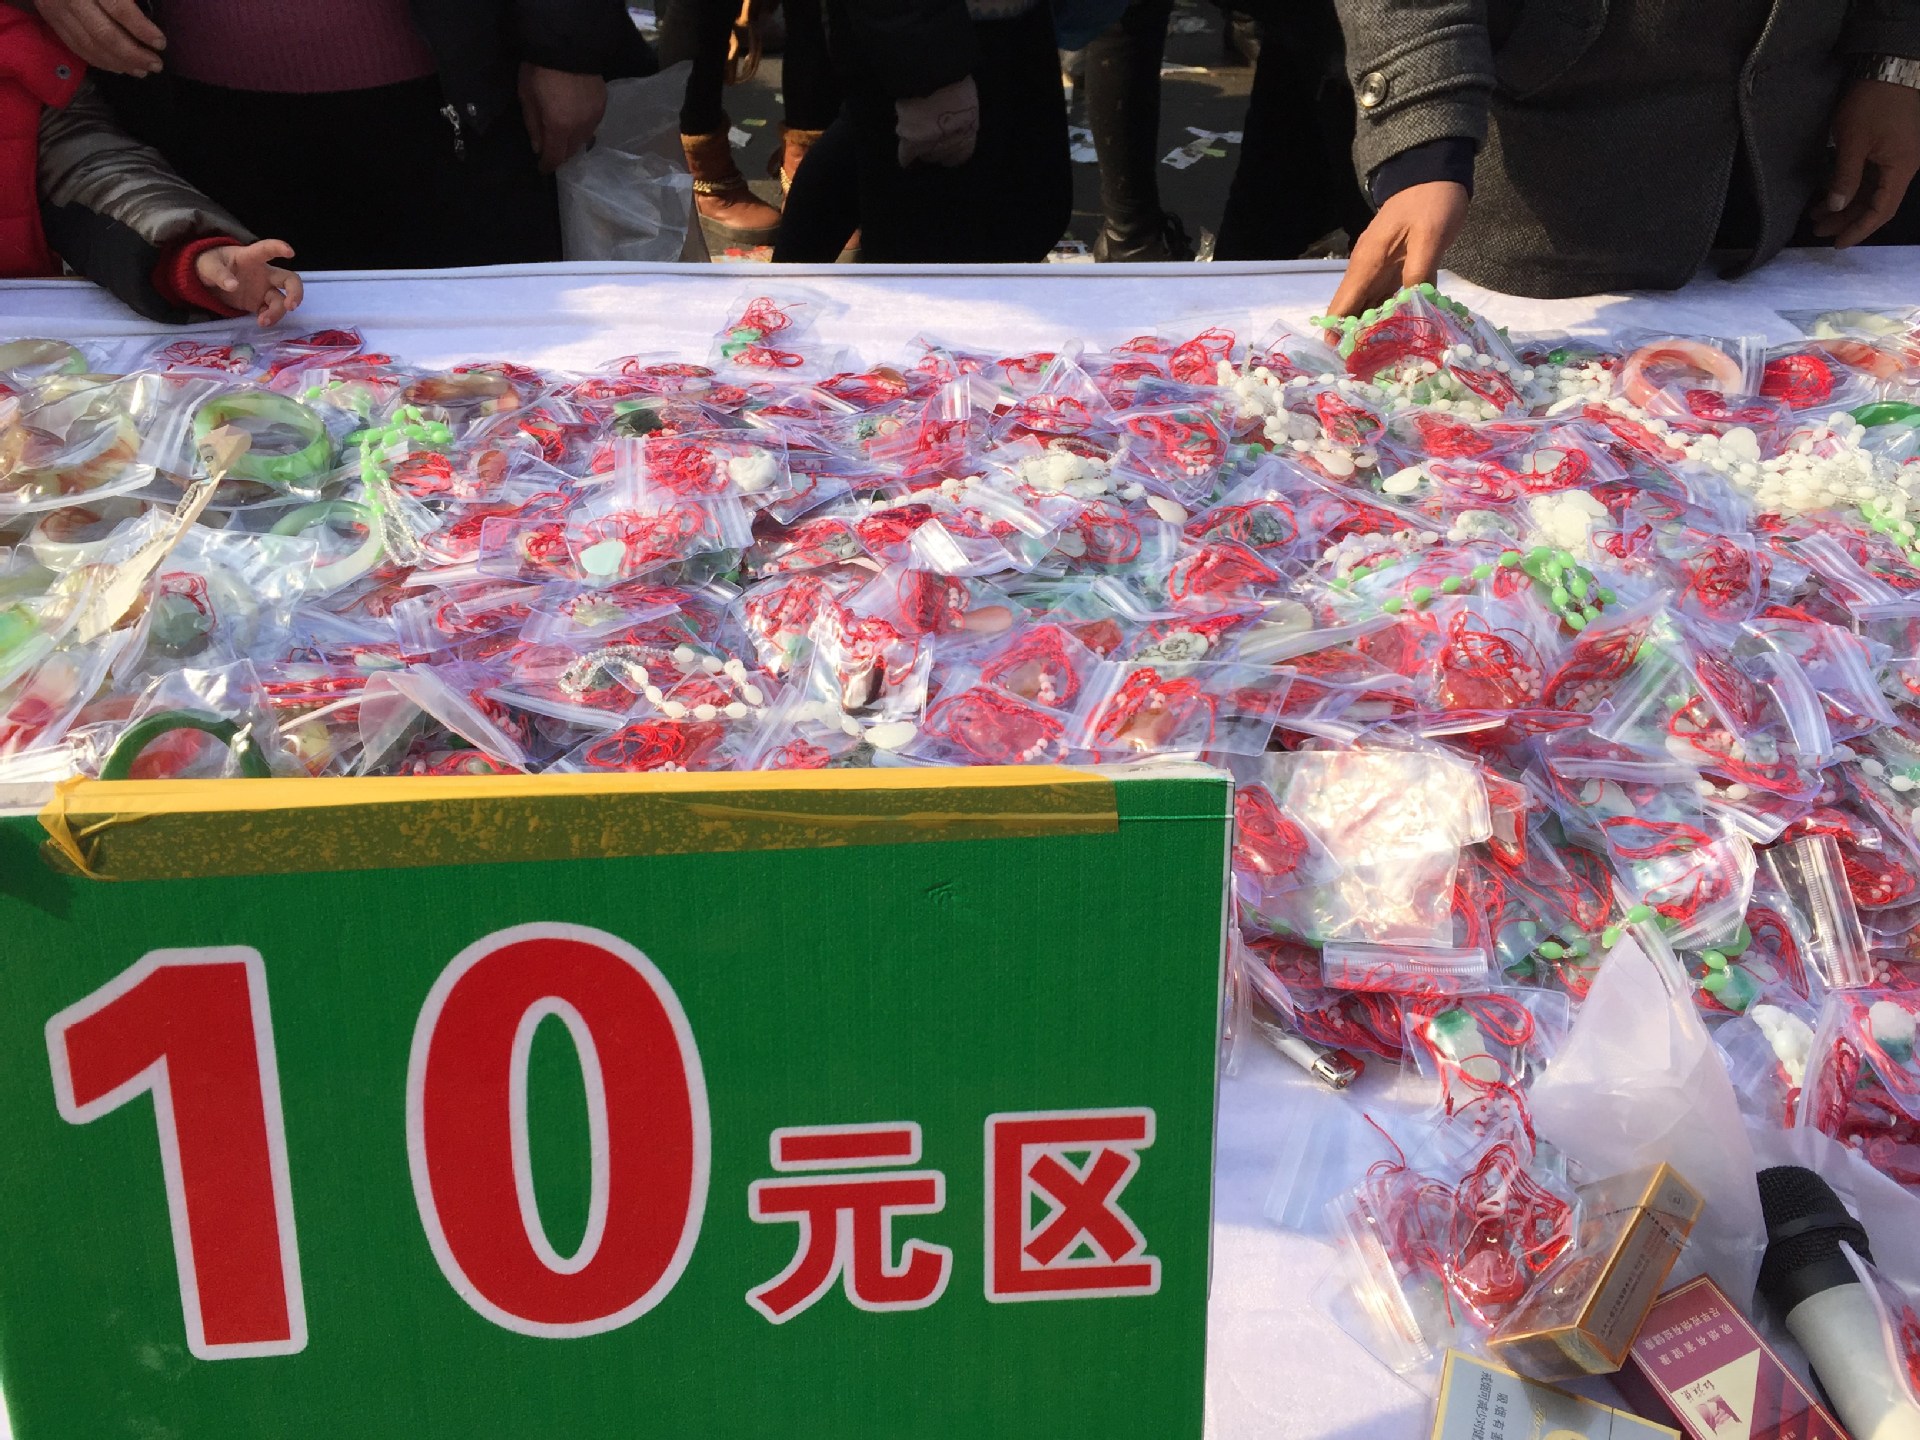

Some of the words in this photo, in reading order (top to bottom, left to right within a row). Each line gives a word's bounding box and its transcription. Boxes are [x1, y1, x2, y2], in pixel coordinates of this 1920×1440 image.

[44, 920, 1161, 1361] 10元区
[1642, 1307, 1721, 1351] 尽早戒烟有益健康
[1658, 1323, 1733, 1366] 吸烟有害健康
[1470, 1371, 1493, 1440] 戒烟可减少对健
